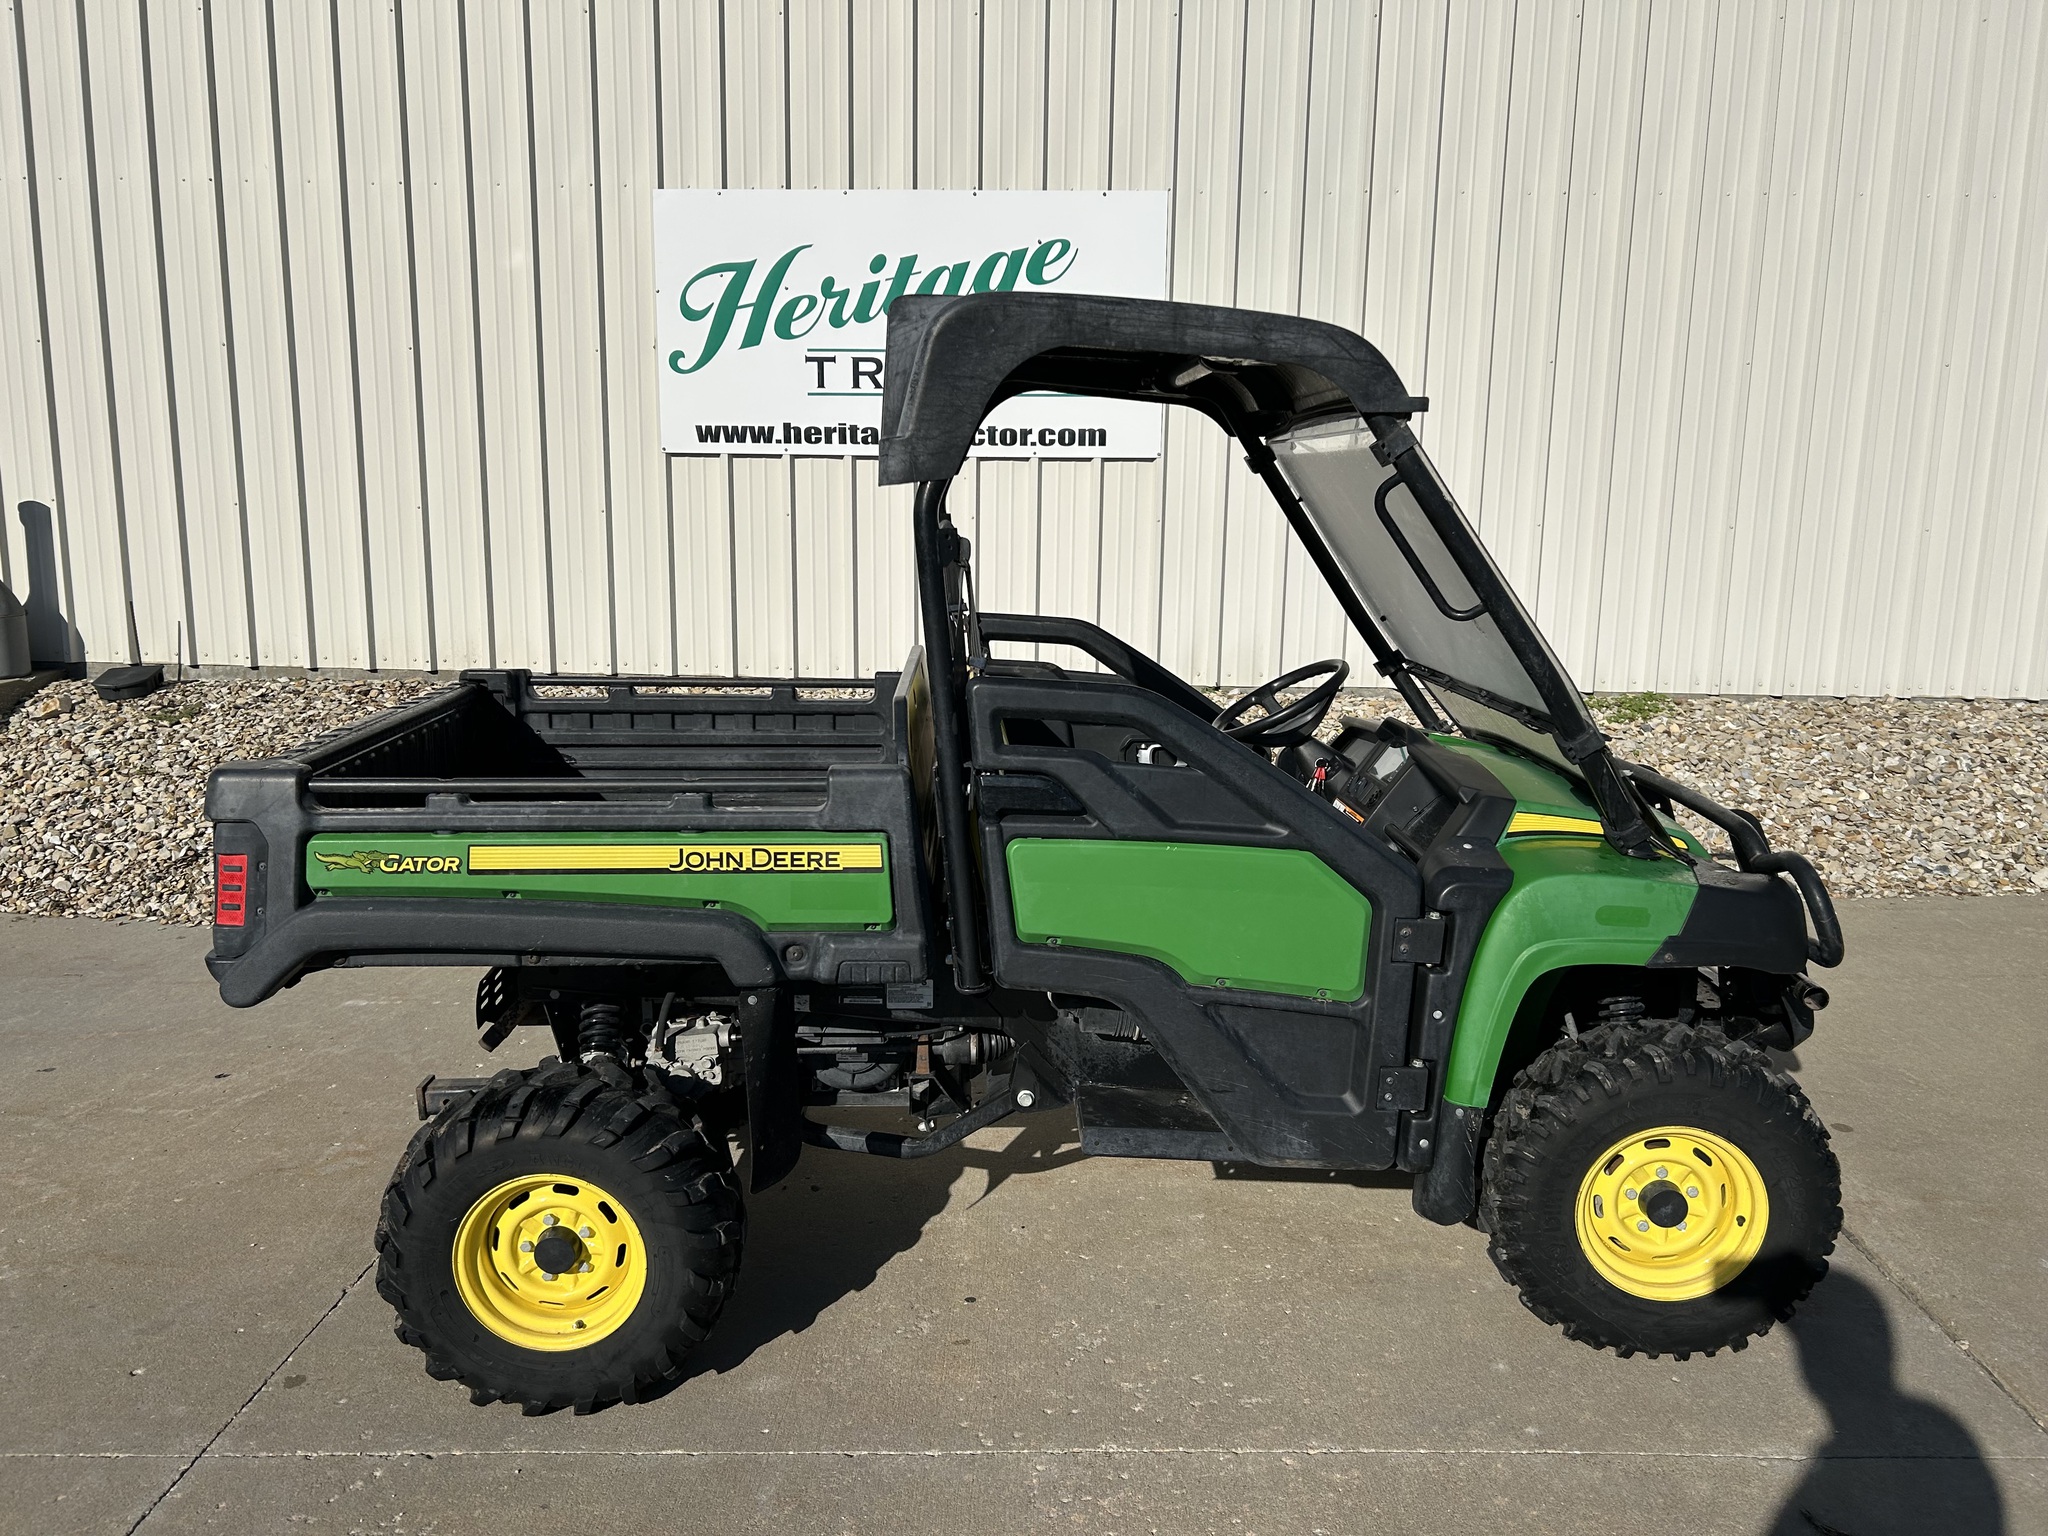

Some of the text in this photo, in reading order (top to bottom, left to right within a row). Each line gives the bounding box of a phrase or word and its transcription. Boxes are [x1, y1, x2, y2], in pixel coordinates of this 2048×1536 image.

[695, 422, 1107, 447] www.heritactor.com
[379, 854, 463, 875] GATOR
[669, 847, 841, 870] JOHN DEERE
